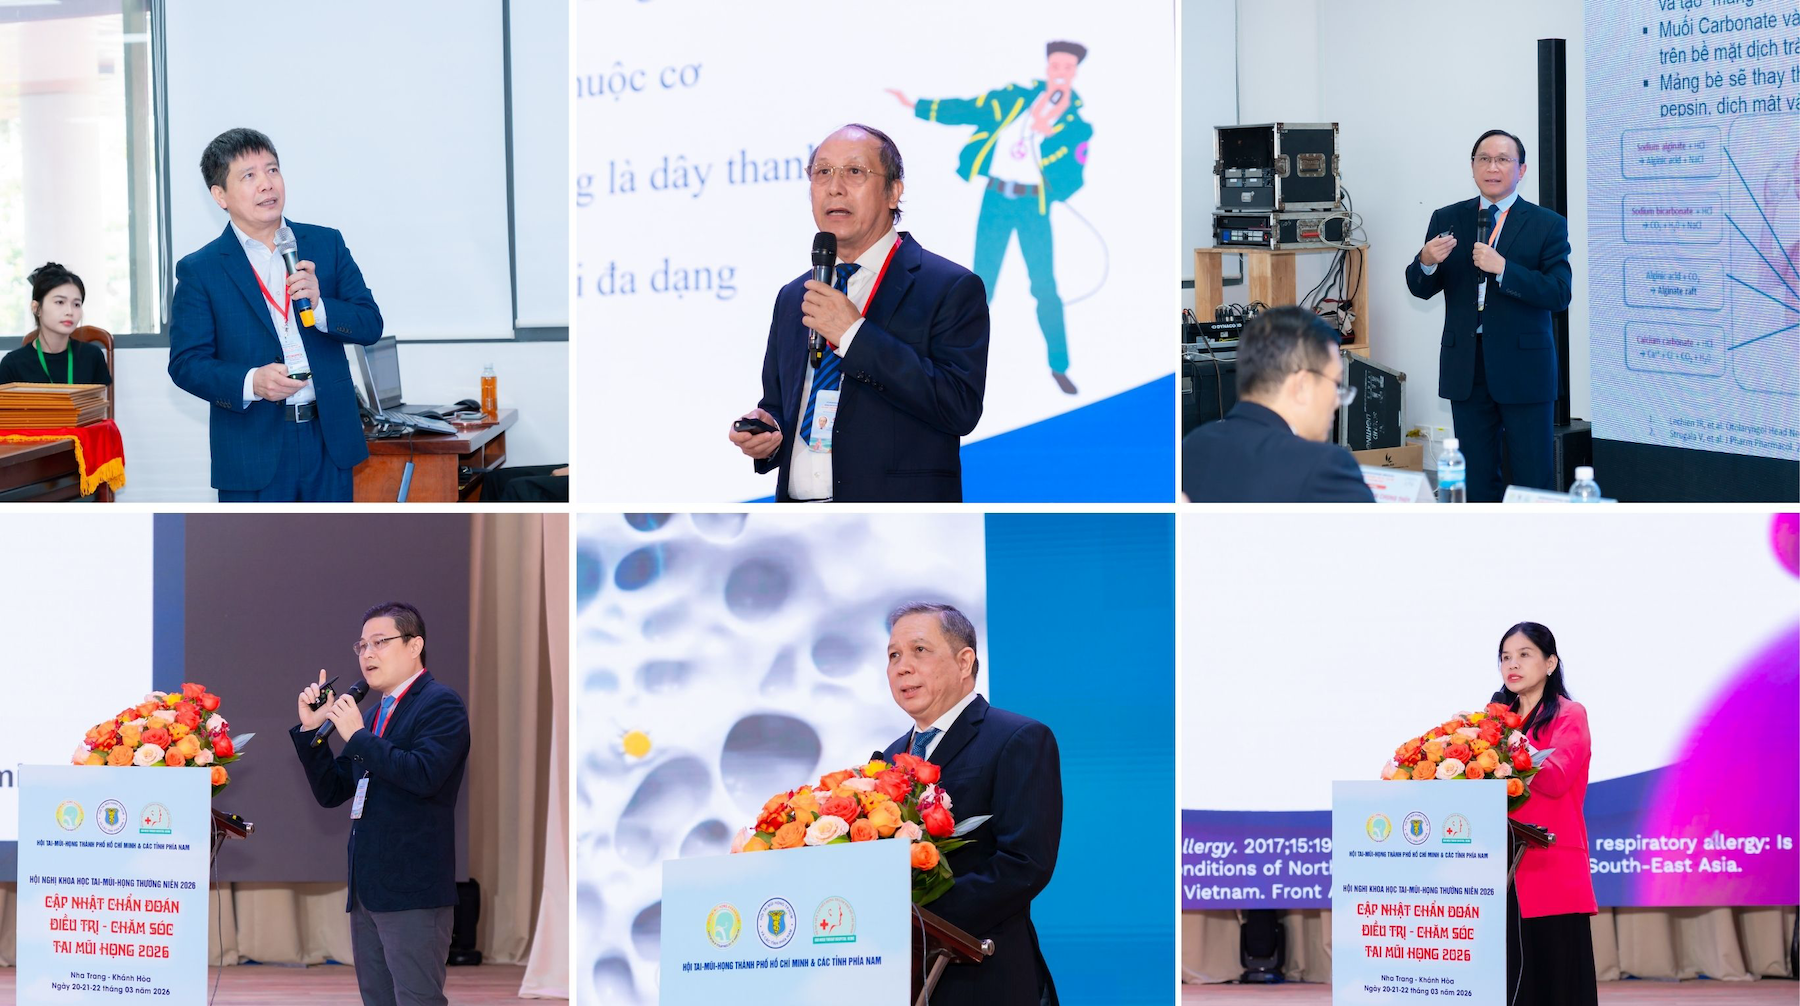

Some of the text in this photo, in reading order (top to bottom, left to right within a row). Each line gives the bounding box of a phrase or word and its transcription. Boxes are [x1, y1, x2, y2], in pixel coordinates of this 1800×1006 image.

[1660, 9, 1800, 38] Muối Carbonate và
[1660, 47, 1686, 65] trên
[1691, 40, 1709, 62] bề
[1714, 42, 1742, 62] mặt
[1747, 39, 1778, 60] dịch
[659, 62, 703, 90] cơ
[1660, 72, 1699, 93] Mảng
[1705, 71, 1723, 88] bè
[1729, 68, 1747, 87] sẽ
[1752, 67, 1785, 89] thay
[608, 160, 637, 195] là
[649, 154, 713, 199] dây
[597, 260, 637, 297] đa
[650, 257, 738, 301] dạng
[1182, 837, 1238, 859] llergy.
[1595, 834, 1793, 855] respiratory allergy: Is
[1262, 859, 1283, 876] of
[1589, 856, 1743, 874] South-East Asia.
[29, 874, 40, 885] HỘI
[42, 876, 57, 886] NGHỊ
[58, 877, 75, 886] KHOA
[76, 877, 90, 888] HỌC
[180, 881, 196, 890] 2026
[1183, 883, 1322, 900] Vietnam. Front
[1343, 884, 1353, 893] HỘI
[1354, 885, 1368, 895] NGHỊ
[1369, 885, 1384, 893] KHOA
[1385, 886, 1397, 895] HỌC
[1480, 887, 1495, 896] 2026
[45, 893, 180, 914] CẬP NHẬT CHẨN ĐOÁN
[1357, 900, 1480, 919] CẬP NHẬT CHẨN ĐOÁN
[50, 913, 77, 931] ĐIỀU
[80, 919, 99, 935] TRỊ
[111, 919, 146, 935] CHĂM
[149, 920, 174, 936] SÓC
[1361, 920, 1387, 937] ĐIỀU
[1389, 925, 1406, 940] TRỊ
[1417, 924, 1449, 939] CHĂM
[1452, 925, 1474, 940] SÓC
[53, 940, 170, 959] TAI MŨI HỌNG 2026
[1365, 945, 1471, 962] TAI MŨI HỌNG 2026
[791, 958, 809, 968] MINH
[817, 956, 830, 967] CÁC
[865, 956, 882, 965] NAM
[87, 972, 107, 981] Trang
[112, 973, 135, 982] Khánh
[136, 975, 151, 983] Hòa
[1396, 975, 1414, 984] Trang
[1418, 976, 1440, 984] Khánh
[1441, 977, 1455, 985] Hòa
[51, 982, 70, 991] Ngày
[72, 983, 101, 992] 20-21-22
[102, 985, 123, 994] tháng
[125, 986, 134, 994] 03
[153, 988, 171, 996] 2026
[1364, 985, 1382, 993] Ngày
[1382, 985, 1409, 994] 20-21-22
[1410, 987, 1429, 996] tháng
